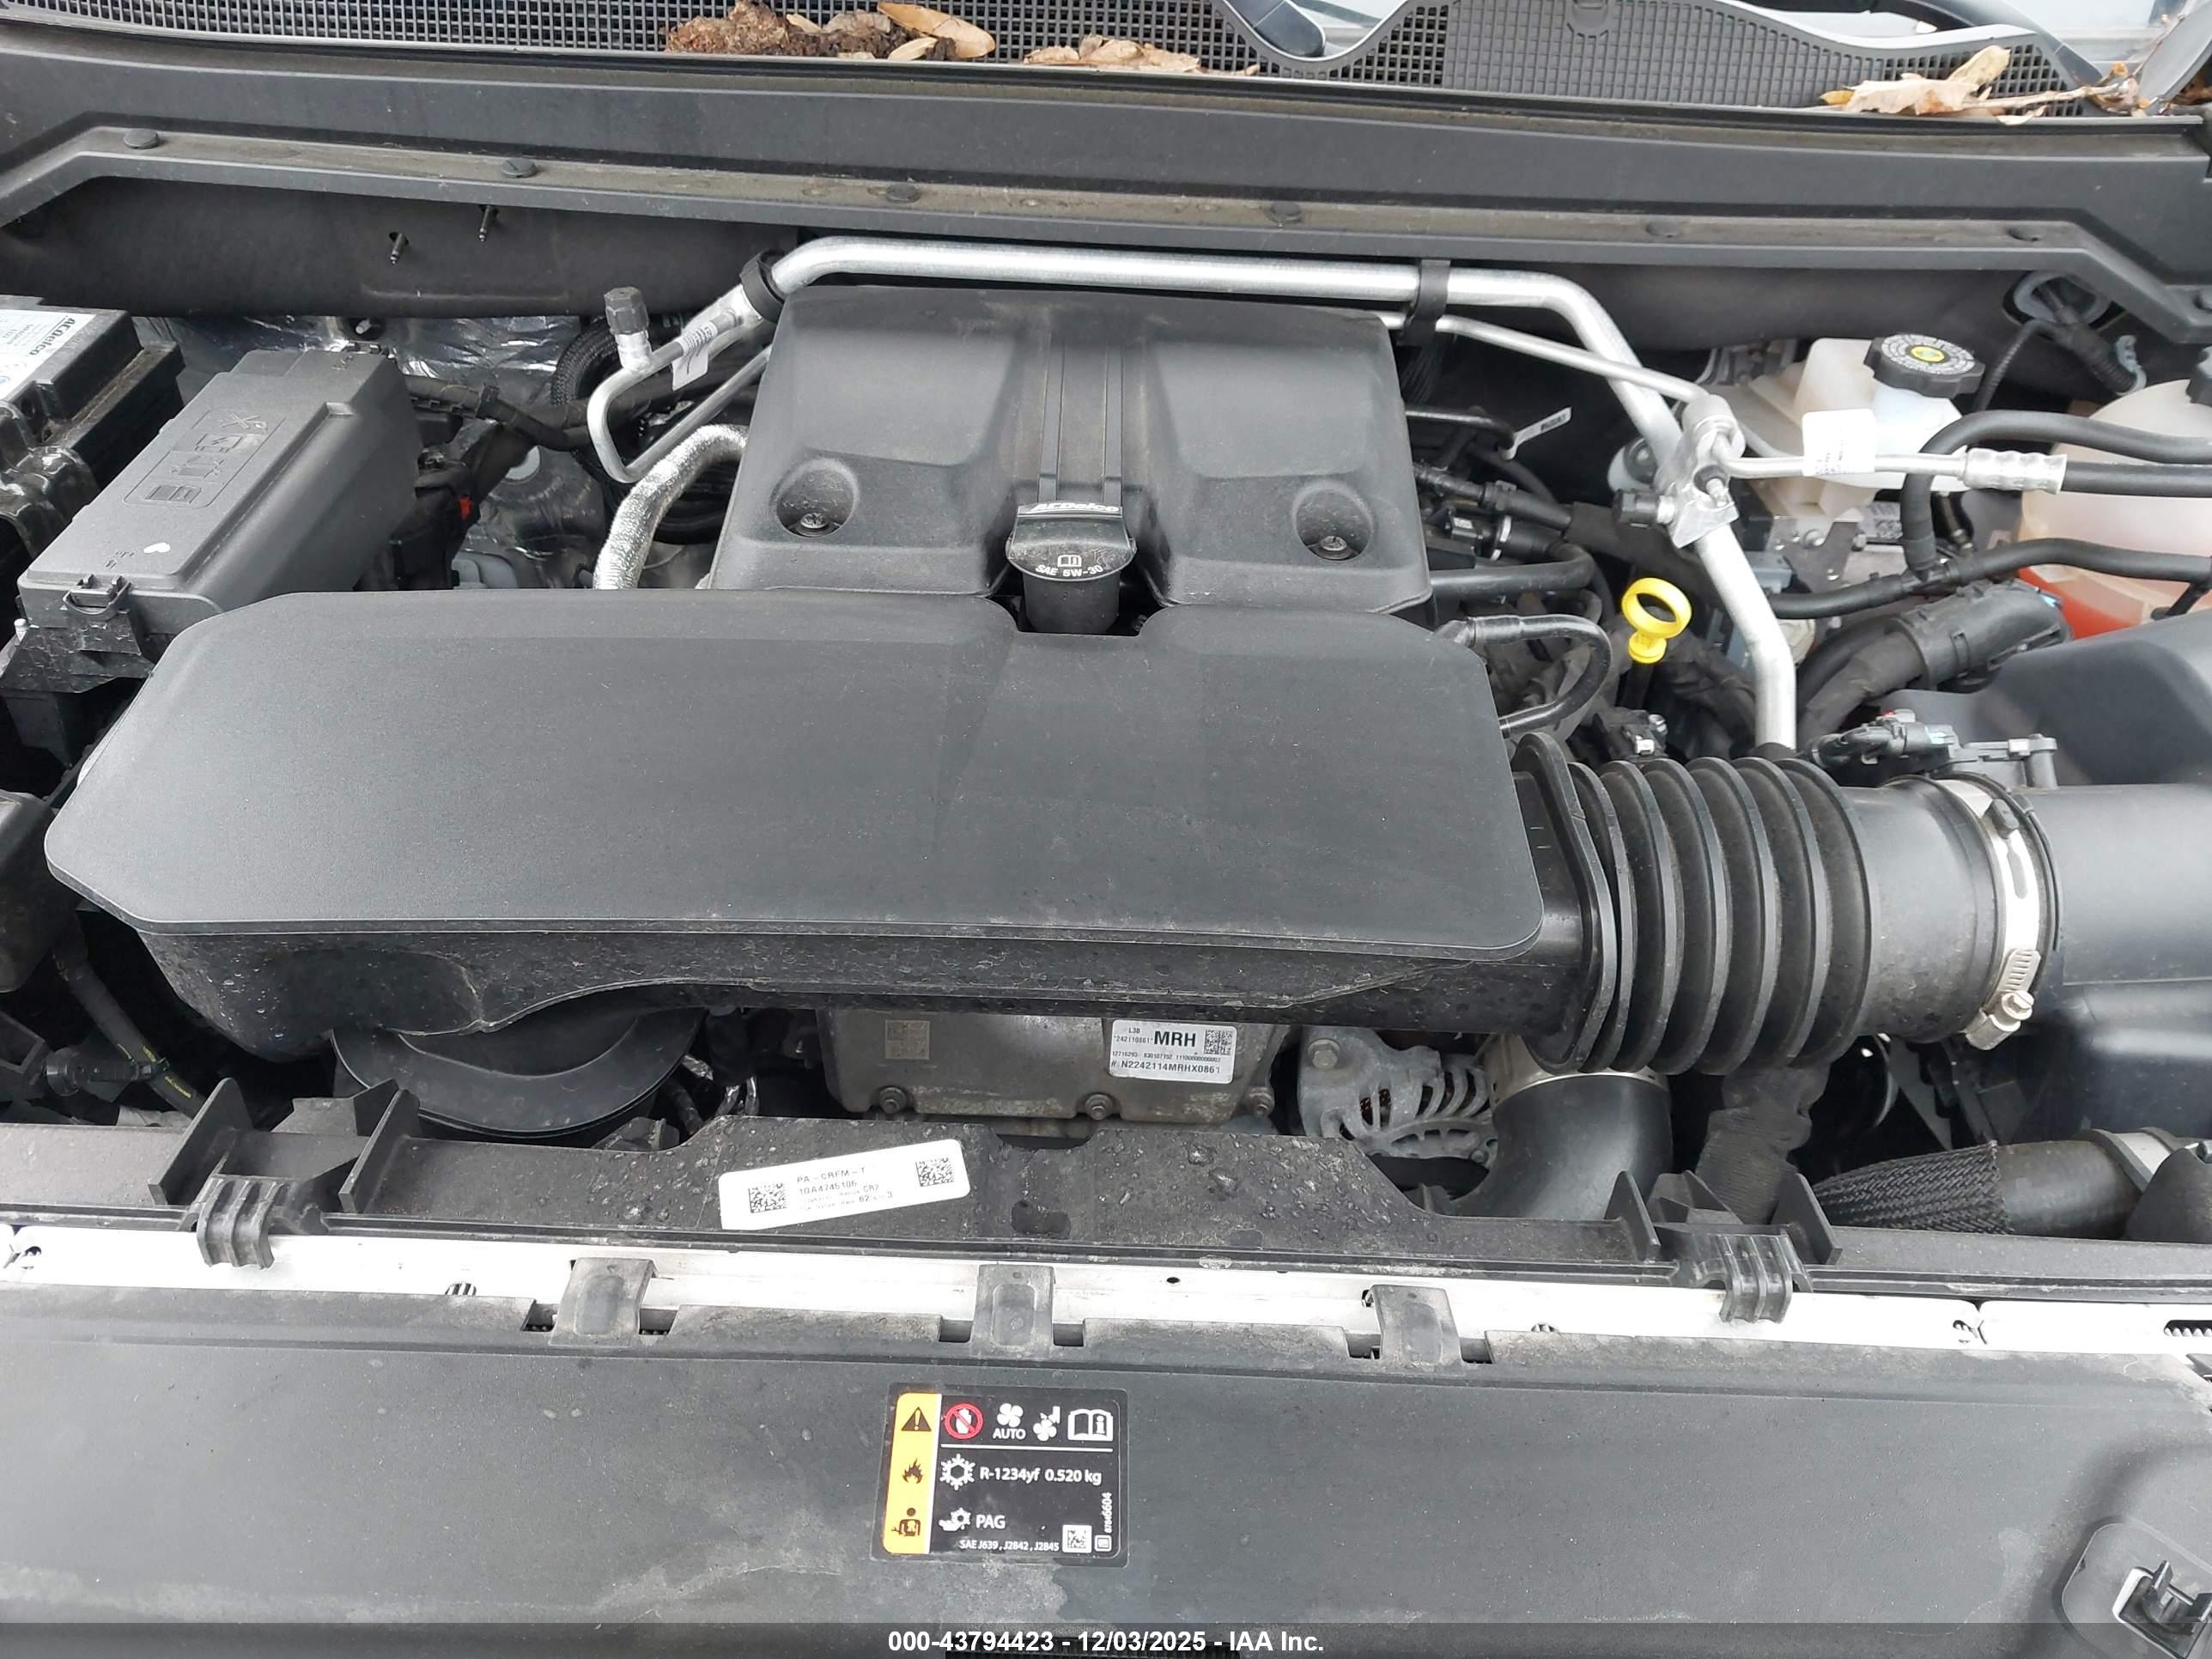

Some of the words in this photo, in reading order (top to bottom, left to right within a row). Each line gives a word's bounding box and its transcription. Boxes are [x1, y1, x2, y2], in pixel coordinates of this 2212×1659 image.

[1036, 564, 1058, 575] SAE
[1153, 1030, 1196, 1047] MRH
[993, 1428, 1026, 1440] AUTO
[980, 1467, 1041, 1484] R-1234yf
[1044, 1468, 1083, 1483] 0.520
[1085, 1469, 1102, 1486] kg
[975, 1514, 1006, 1528] PAG
[959, 1540, 977, 1549] SAE
[1034, 1541, 1060, 1552] J2845
